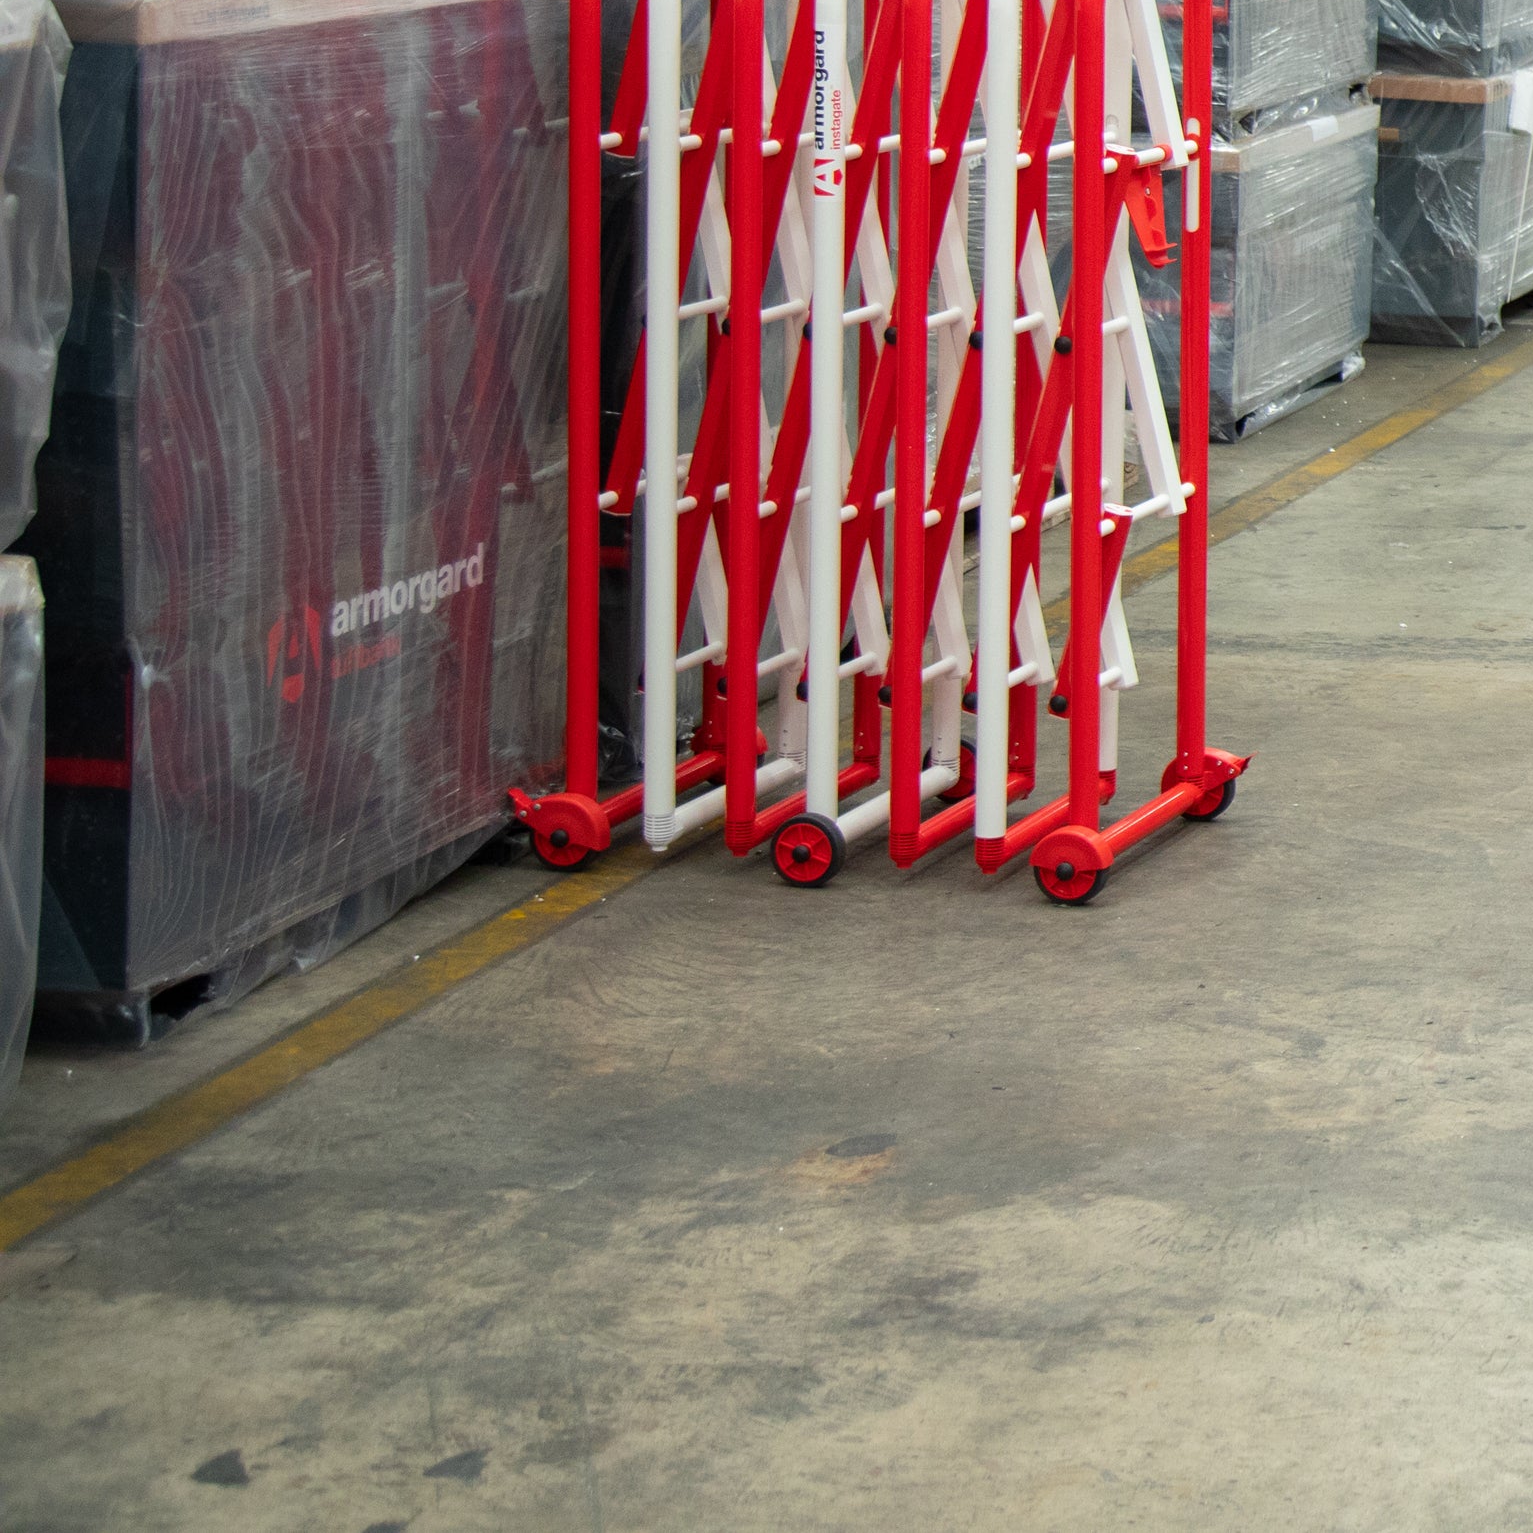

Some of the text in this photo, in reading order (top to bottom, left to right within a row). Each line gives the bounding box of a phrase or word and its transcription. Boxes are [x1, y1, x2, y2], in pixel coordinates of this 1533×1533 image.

[815, 30, 829, 151] armorgard
[830, 89, 844, 150] instagate
[331, 542, 484, 637] armorgard
